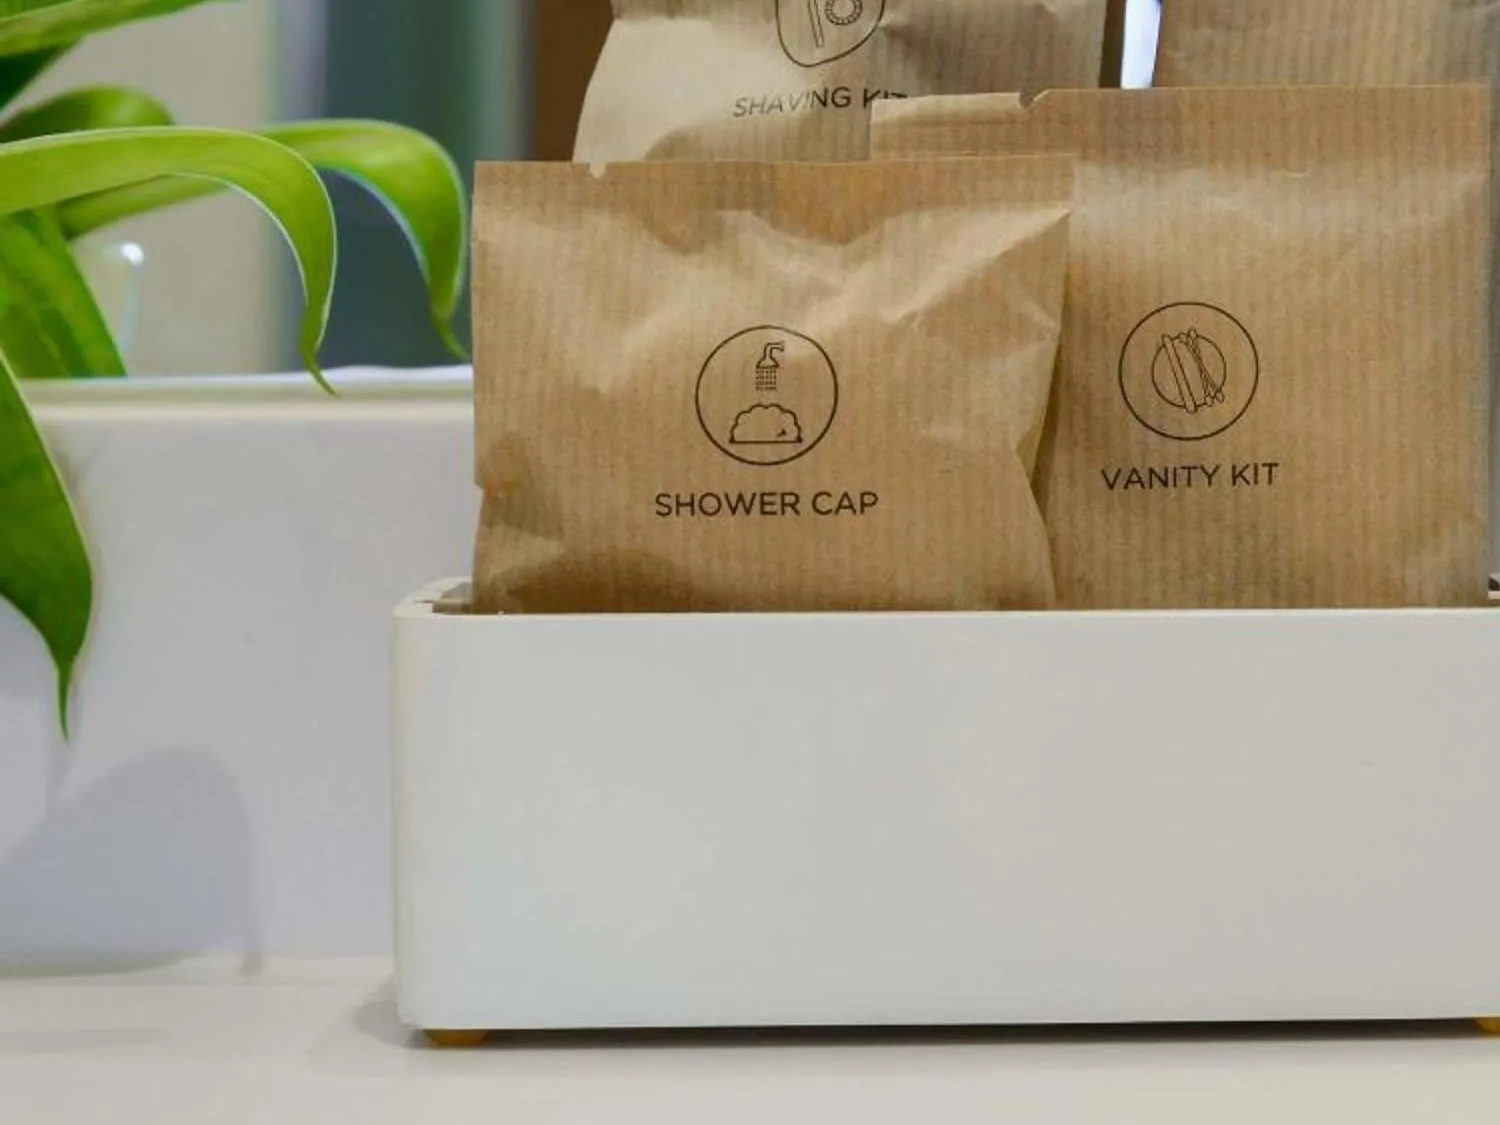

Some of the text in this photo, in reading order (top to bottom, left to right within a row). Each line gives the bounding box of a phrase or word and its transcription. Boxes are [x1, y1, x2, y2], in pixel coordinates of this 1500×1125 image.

[732, 86, 852, 117] SHAVING
[1100, 461, 1280, 491] VANITY KIT
[655, 490, 879, 518] SHOWER CAP
